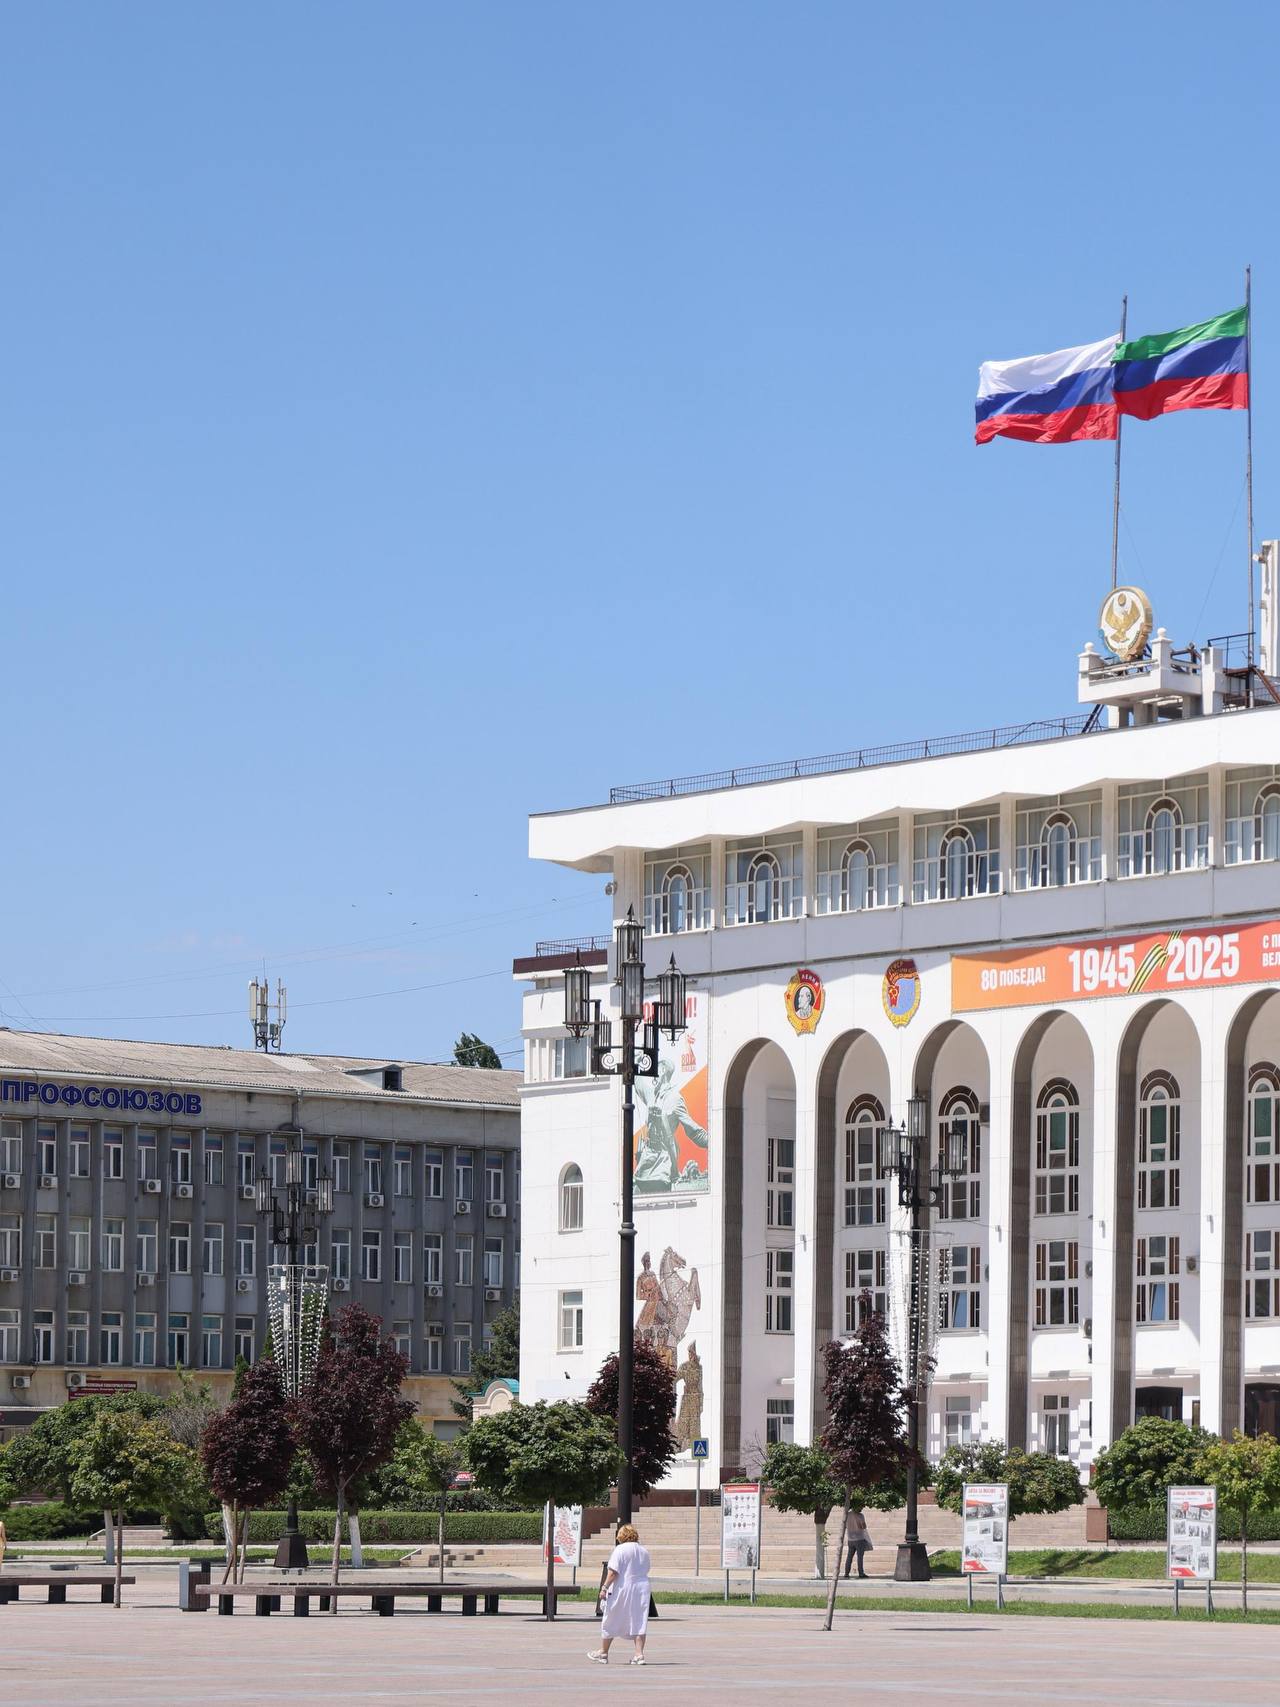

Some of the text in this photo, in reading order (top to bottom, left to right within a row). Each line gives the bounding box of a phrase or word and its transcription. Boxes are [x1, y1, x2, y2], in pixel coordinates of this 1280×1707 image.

[1262, 934, 1270, 949] С
[1068, 933, 1240, 992] 1945 2025
[980, 966, 1046, 991] 80 ПОБЕДА!
[2, 1080, 202, 1115] ПРОФСОЮЗОВ
